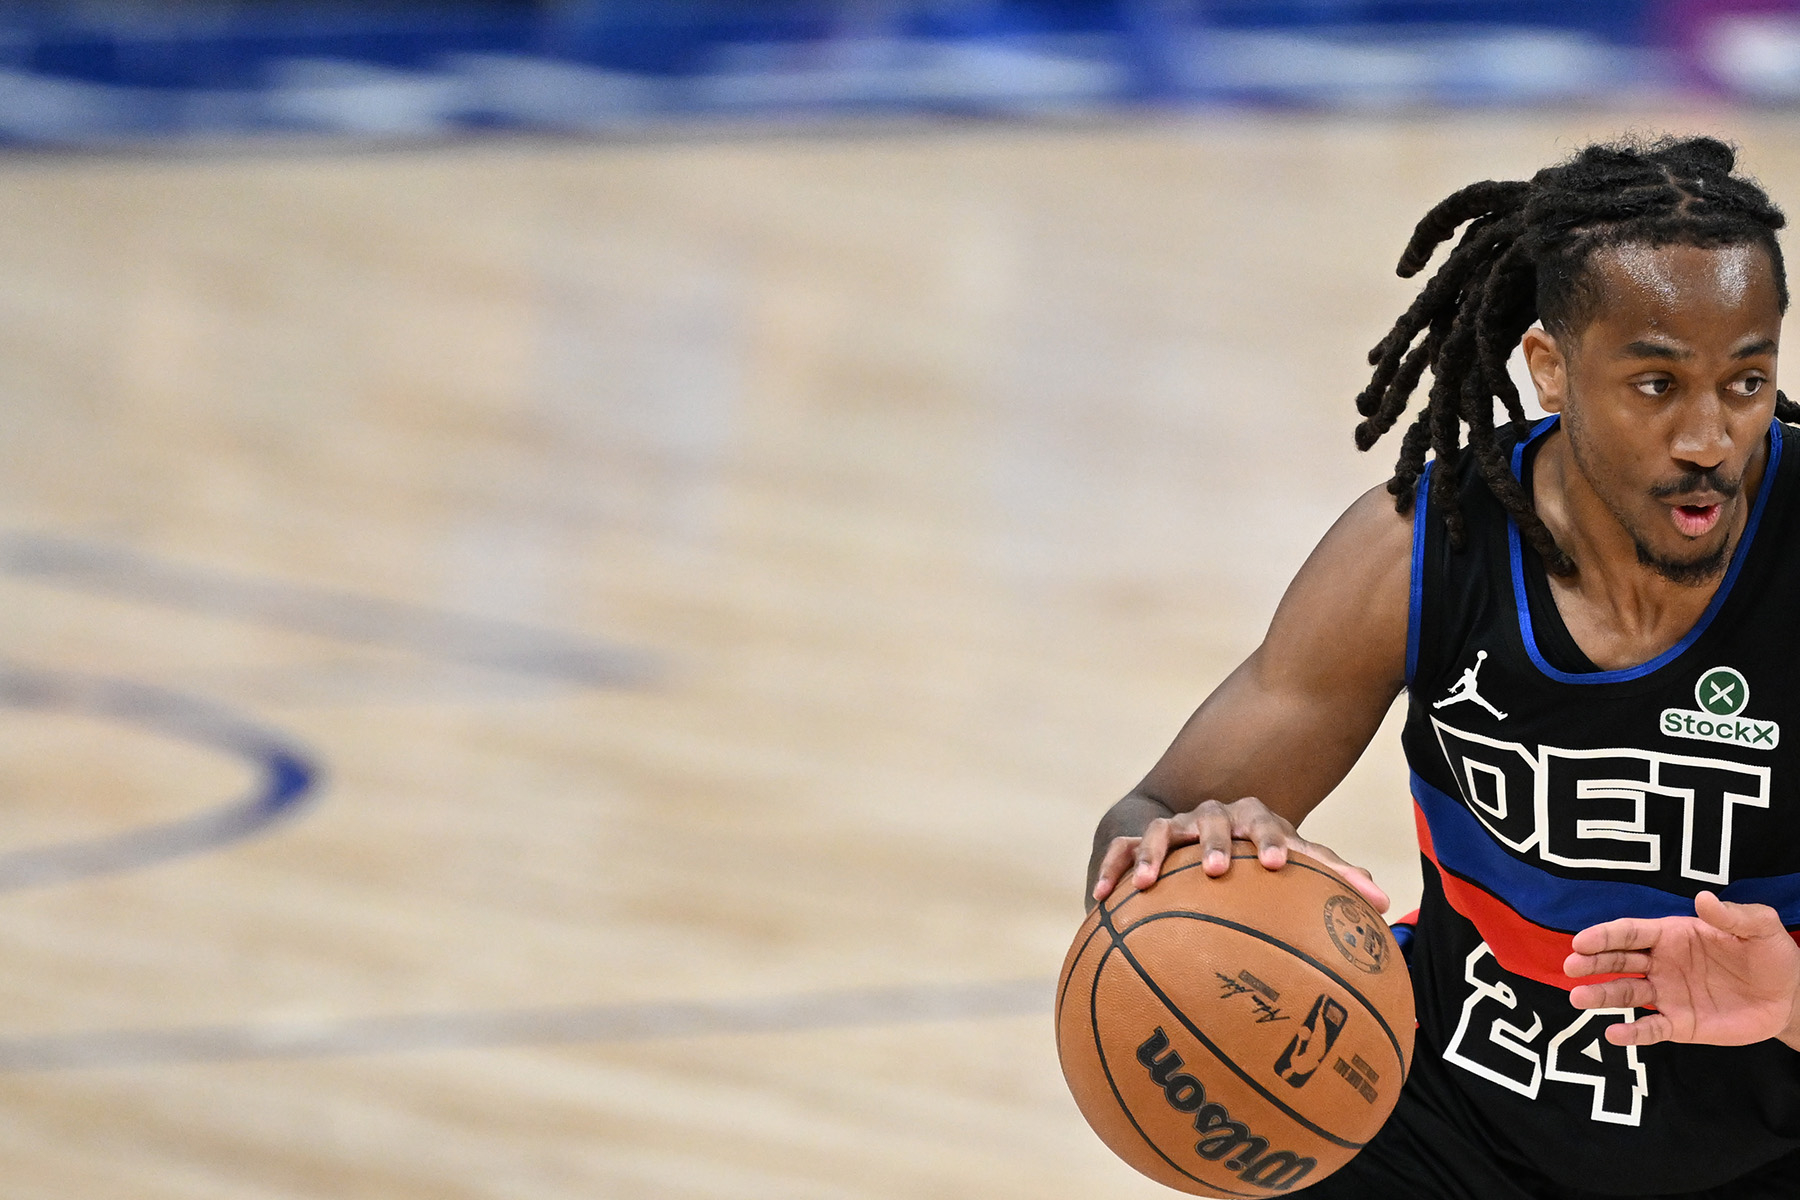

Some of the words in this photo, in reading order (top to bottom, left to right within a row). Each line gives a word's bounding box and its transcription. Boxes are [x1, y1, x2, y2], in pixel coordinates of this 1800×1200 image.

[1429, 714, 1771, 886] DET
[1663, 712, 1776, 746] StockX
[1136, 1026, 1318, 1191] Wilson
[1442, 941, 1649, 1127] 24
